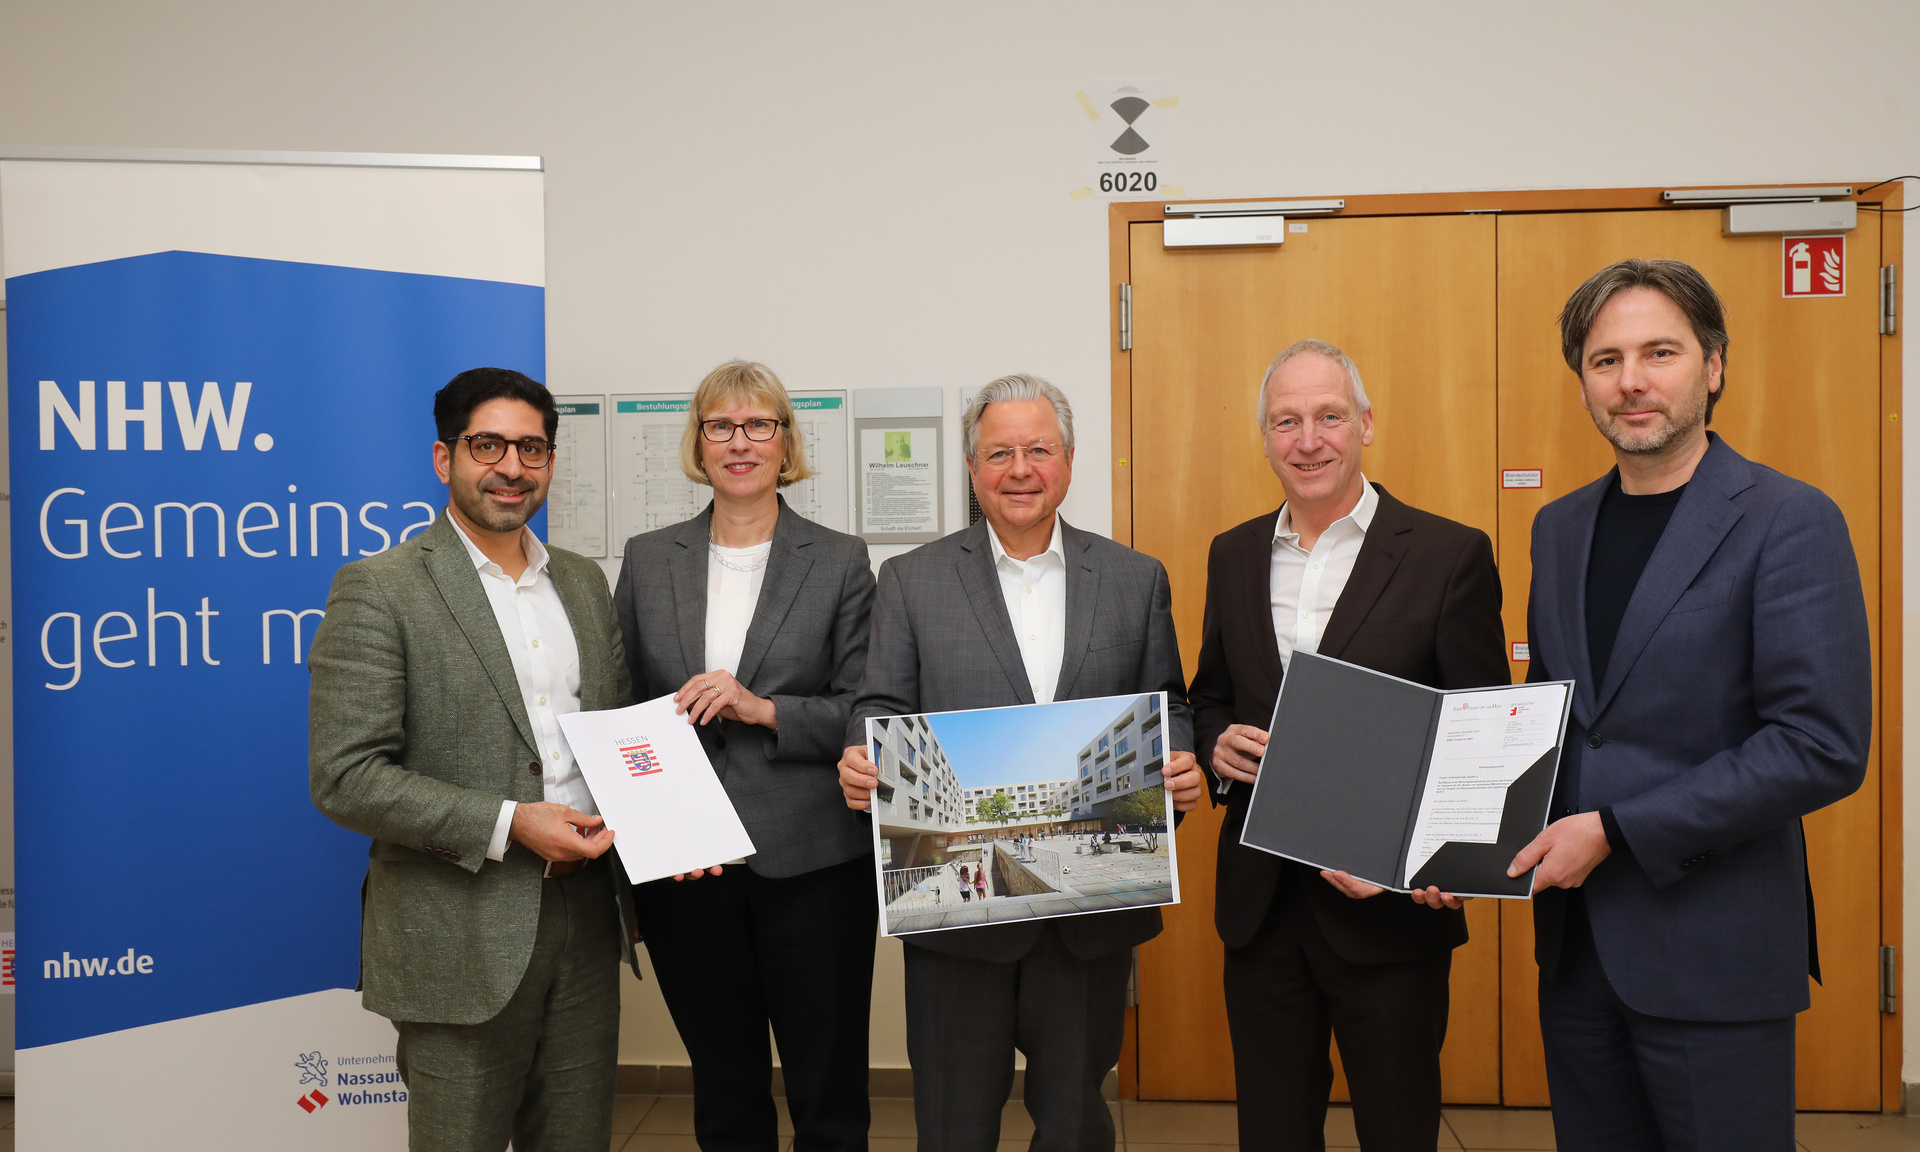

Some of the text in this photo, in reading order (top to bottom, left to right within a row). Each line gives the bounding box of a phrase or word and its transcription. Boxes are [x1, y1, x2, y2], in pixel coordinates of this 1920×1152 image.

[1100, 172, 1157, 192] 6020
[39, 380, 274, 451] NHW.
[39, 484, 436, 560] Gemeinsa
[40, 587, 220, 691] geht
[614, 735, 649, 746] HESSEN
[43, 947, 154, 979] nhw.de
[337, 1054, 395, 1066] Unternehm
[337, 1069, 404, 1086] Nassaui
[337, 1090, 408, 1106] Wohnsta
